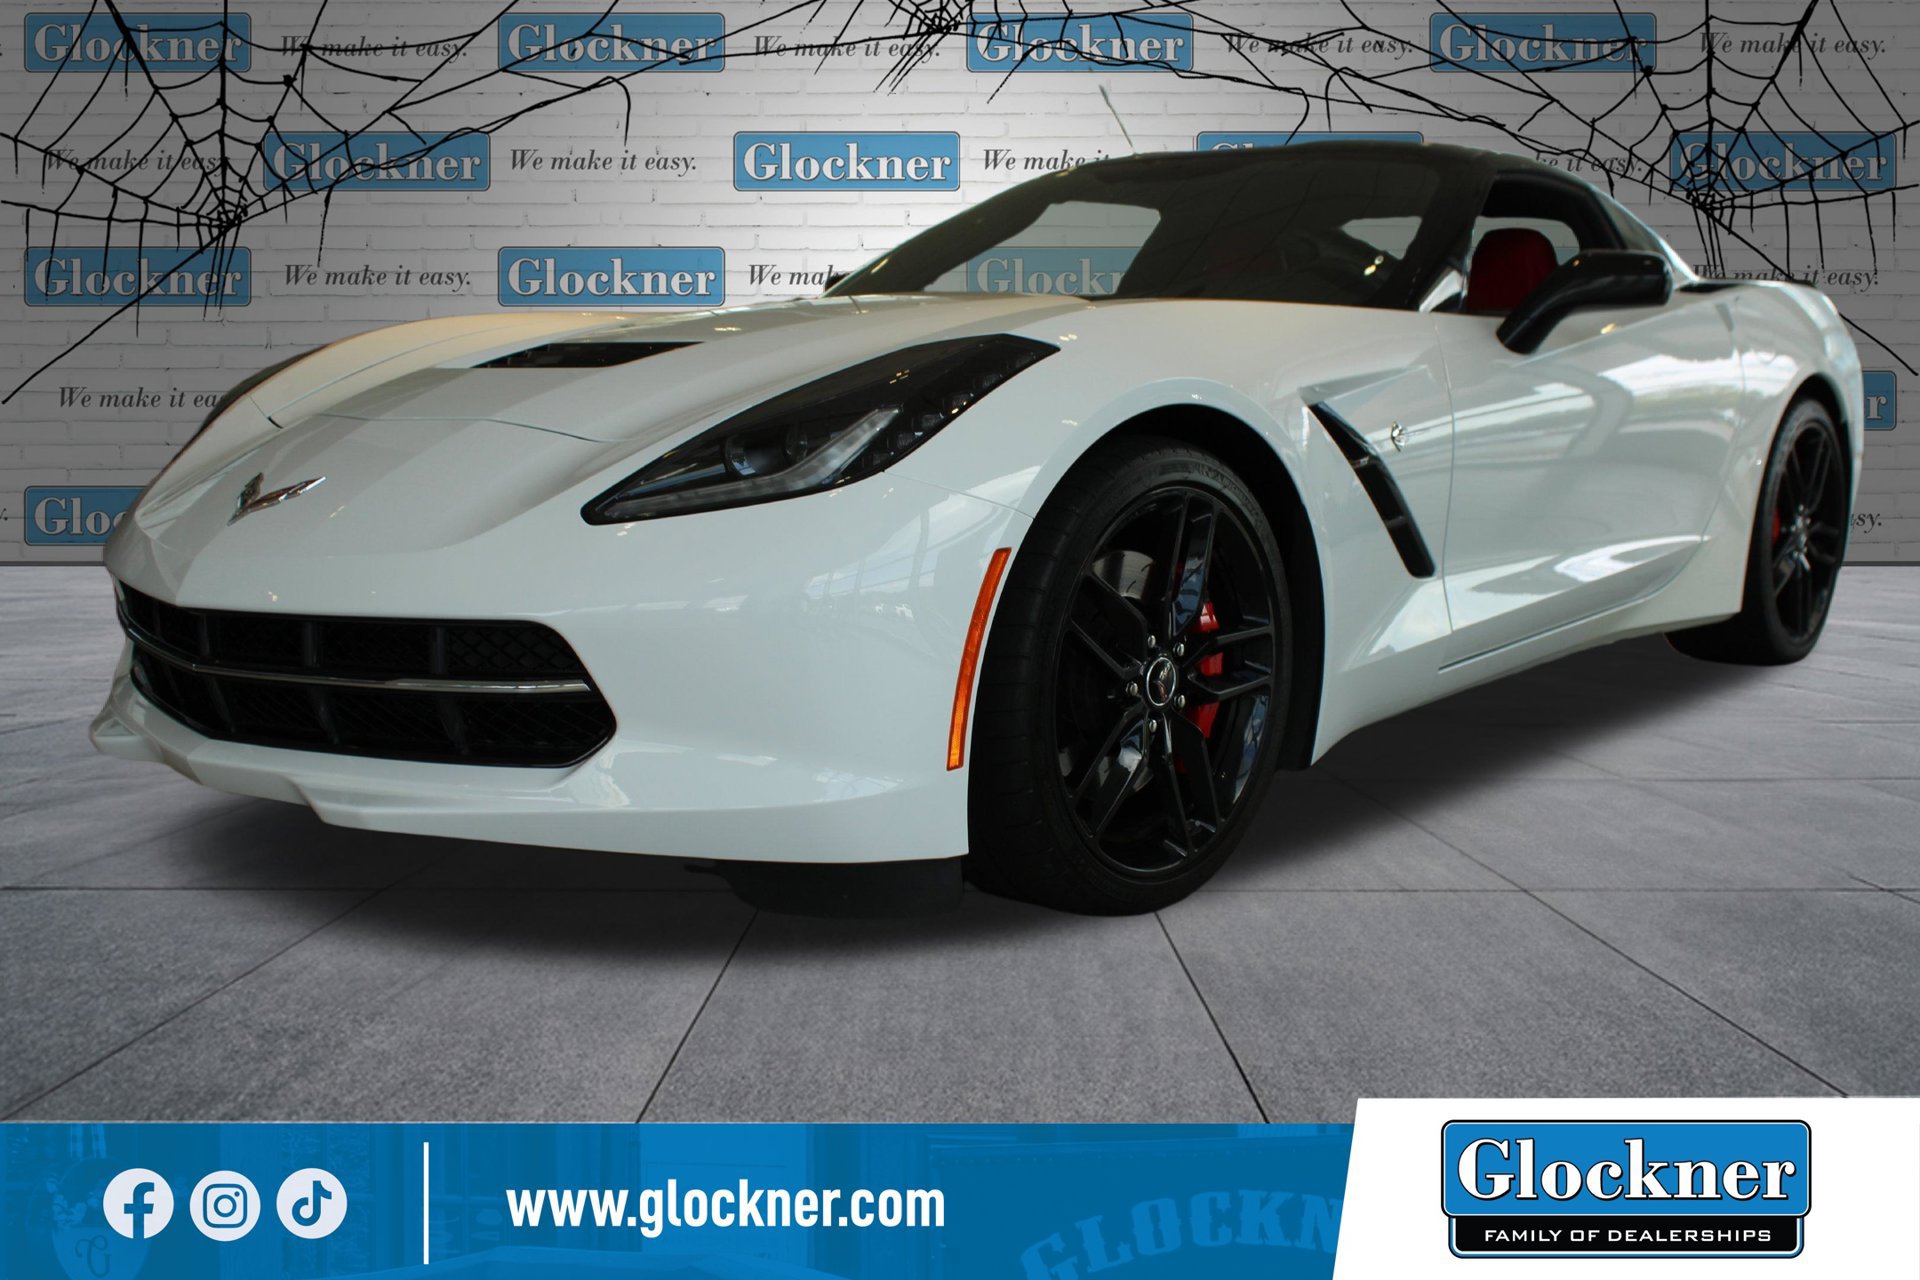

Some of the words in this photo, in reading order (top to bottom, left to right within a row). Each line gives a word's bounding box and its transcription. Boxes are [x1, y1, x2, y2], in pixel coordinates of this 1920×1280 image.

[34, 24, 242, 62] Glockner
[322, 35, 383, 56] make
[391, 36, 407, 56] it
[416, 43, 467, 63] easy.
[507, 24, 716, 62] Glockner
[754, 35, 786, 56] We
[795, 35, 856, 56] make
[864, 36, 881, 56] it
[888, 43, 940, 63] easy.
[976, 24, 1184, 62] Glockner
[1226, 32, 1260, 53] We
[1337, 32, 1354, 53] it
[1362, 40, 1413, 60] easy.
[1440, 24, 1648, 62] Glockner
[1700, 32, 1732, 53] We
[1811, 32, 1827, 53] it
[1834, 40, 1886, 60] easy.
[45, 149, 78, 170] We
[86, 149, 148, 170] make
[157, 149, 174, 170] it
[272, 142, 481, 182] Glockner
[510, 149, 543, 170] We
[551, 149, 613, 170] make
[620, 149, 637, 170] it
[645, 156, 696, 177] easy.
[743, 142, 951, 182] Glockner
[983, 149, 1016, 170] We
[1024, 149, 1085, 170] make
[1679, 142, 1887, 182] Glockner
[34, 257, 242, 296] Glockner
[284, 265, 317, 286] We
[325, 264, 387, 286] make
[395, 265, 411, 286] it
[419, 272, 471, 292] easy.
[508, 258, 716, 296] Glockner
[748, 264, 781, 286] We
[1803, 264, 1819, 286] it
[1827, 271, 1878, 292] easy.
[59, 386, 92, 408] We
[99, 386, 161, 408] make
[169, 387, 186, 408] it
